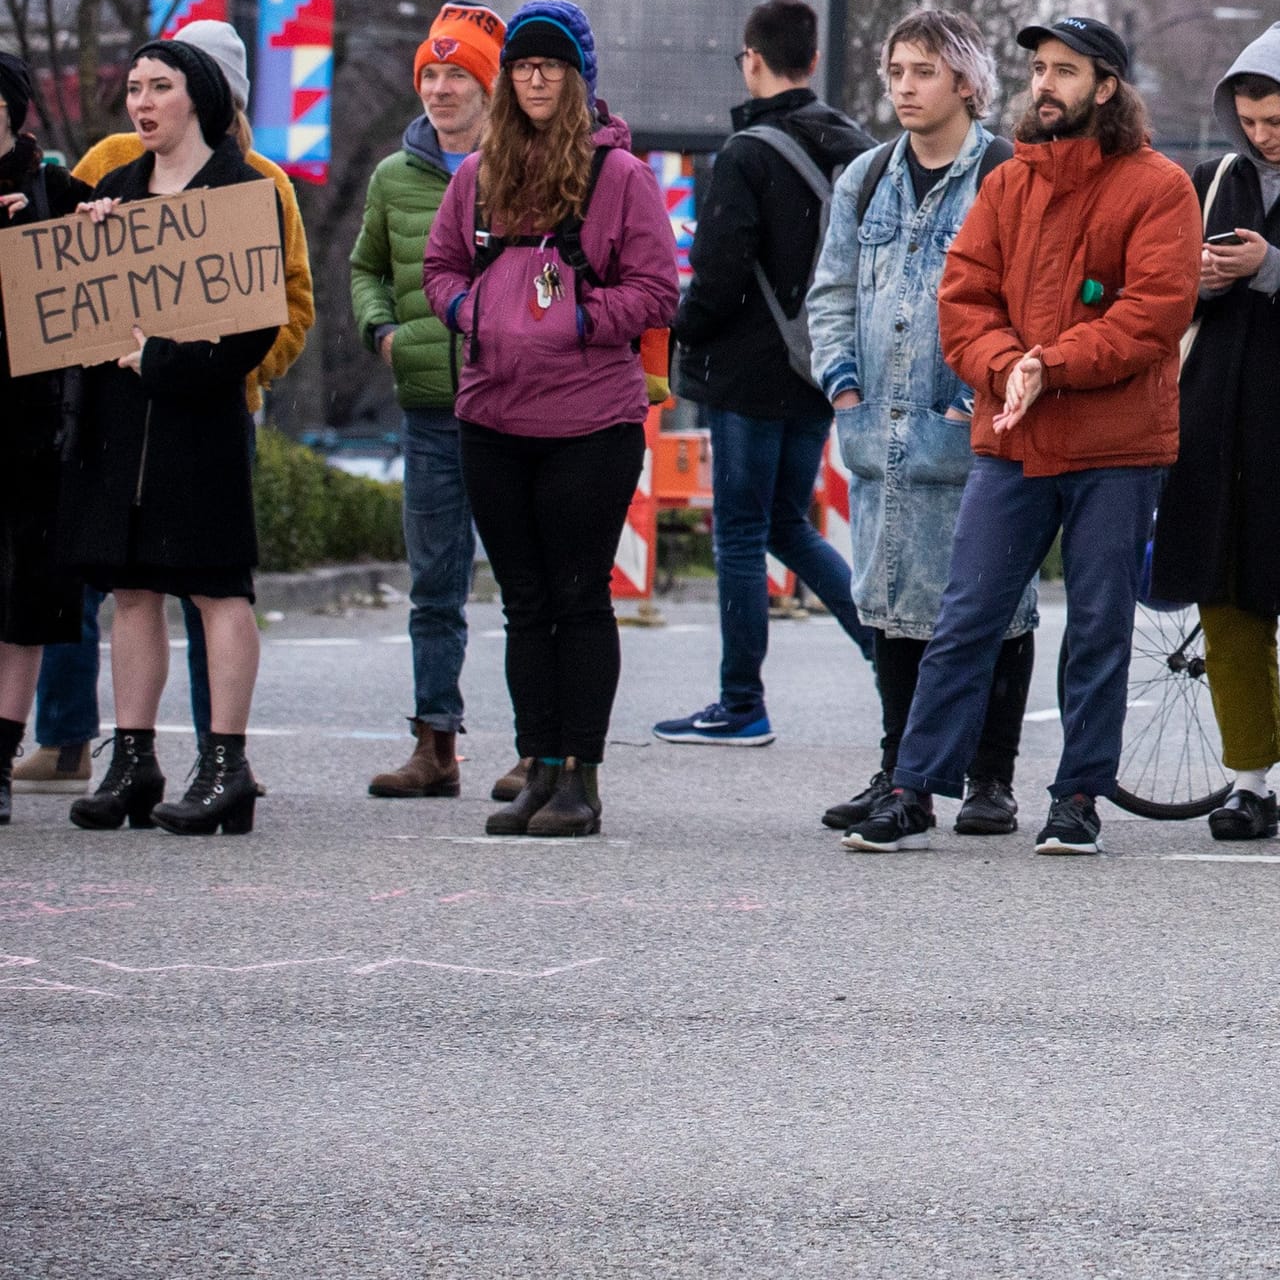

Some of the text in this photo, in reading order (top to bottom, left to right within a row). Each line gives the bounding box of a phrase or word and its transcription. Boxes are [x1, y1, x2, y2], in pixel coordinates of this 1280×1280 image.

[22, 200, 207, 270] TRUDEAU
[35, 245, 282, 344] EAT MY BUTT
